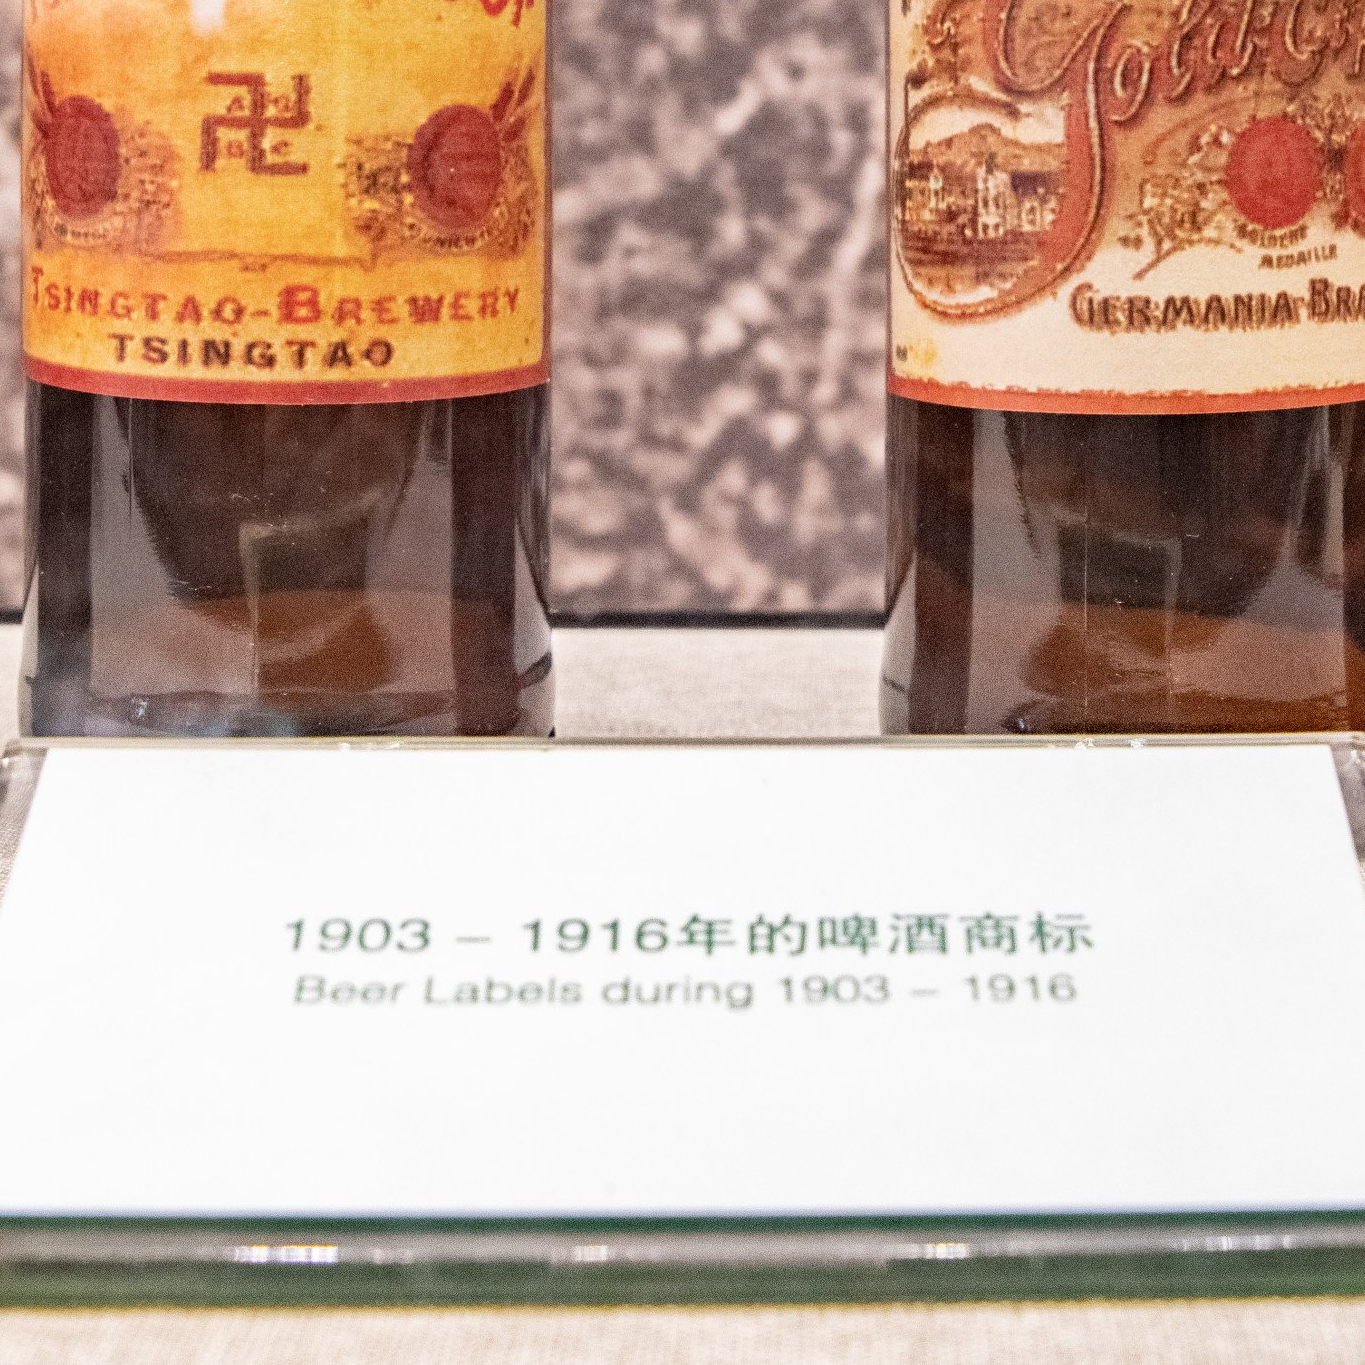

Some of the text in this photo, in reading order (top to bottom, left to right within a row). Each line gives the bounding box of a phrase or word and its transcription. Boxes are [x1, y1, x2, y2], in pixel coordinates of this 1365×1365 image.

[31, 266, 520, 326] TSINGTAO-BREWERY
[107, 332, 396, 370] TSINGTAO
[286, 917, 431, 954] 1903
[521, 913, 1094, 956] 1916年的啤酒商标
[293, 972, 407, 1005] Beer
[423, 975, 583, 1005] Labels
[600, 975, 756, 1011] during
[778, 973, 892, 1004] 1903
[964, 972, 1078, 1004] 1916
